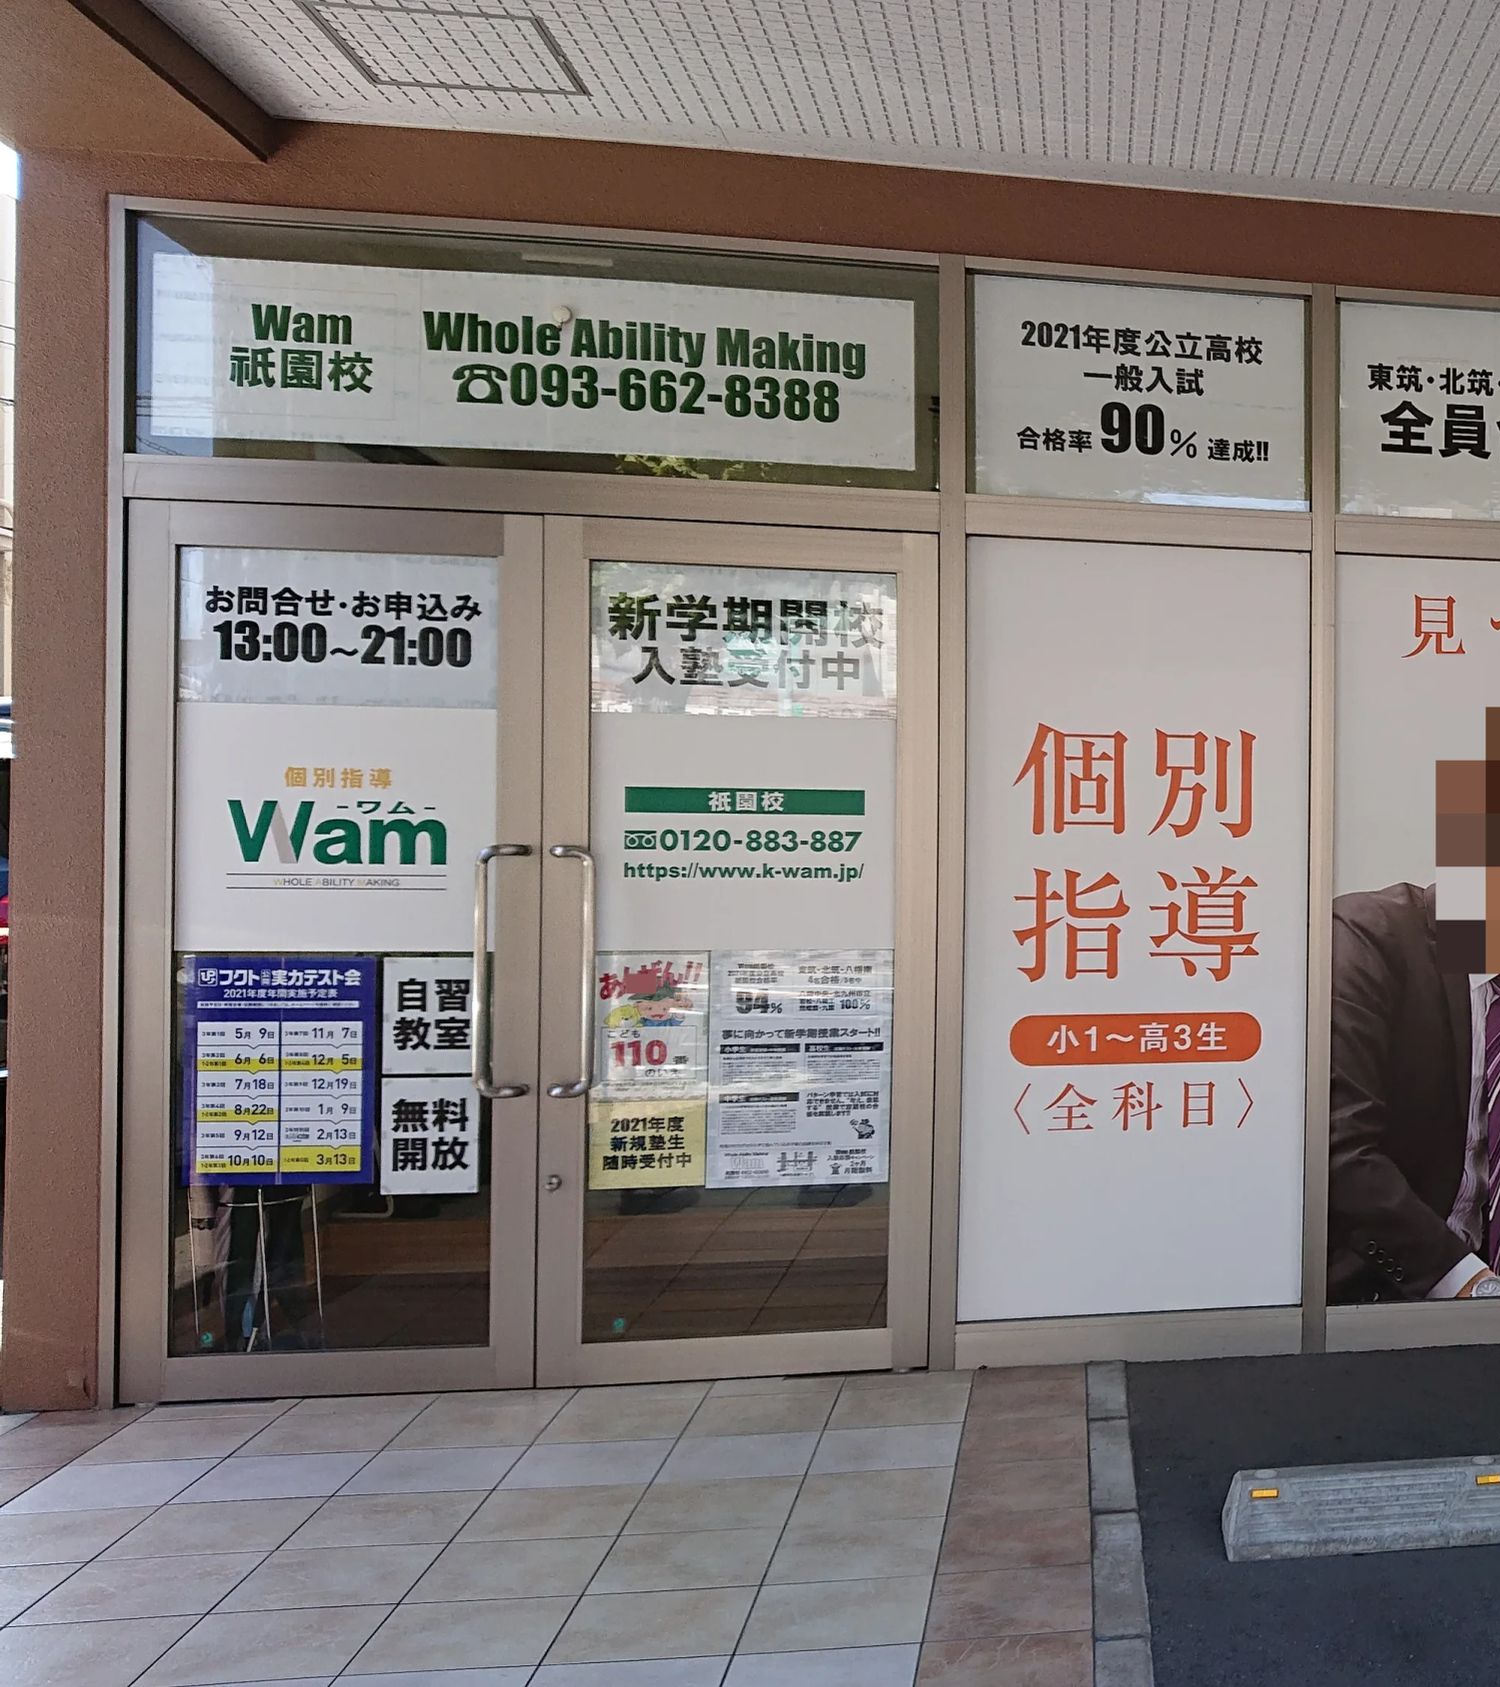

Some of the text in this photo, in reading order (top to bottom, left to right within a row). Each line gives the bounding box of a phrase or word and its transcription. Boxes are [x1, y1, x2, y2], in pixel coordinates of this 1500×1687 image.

[252, 303, 352, 346] Wam
[423, 310, 866, 381] Whole Ability Making
[1021, 320, 1263, 366] 2021年度公立高校
[229, 346, 373, 394] 祇園校
[1083, 362, 1205, 397] 一般入試
[510, 361, 841, 425] 093-662-8388
[1016, 401, 1269, 464] 合格率 90% 達成!!
[205, 585, 482, 622] お問合せ・お申込み
[212, 619, 473, 668] 13:00～21:00
[631, 645, 861, 690] 入塾受付中
[284, 766, 393, 789] 個別指導
[1012, 722, 1257, 840] 個別
[707, 790, 785, 813] 祇園校
[227, 799, 448, 866] Wam
[659, 828, 863, 853] 0120-883-887
[273, 877, 401, 887] WHOLE ABILITY MAKING
[623, 861, 865, 883] https://www.k-wam.jp/
[1012, 865, 1260, 983] 指導
[397, 978, 470, 1012] 自習
[393, 1017, 471, 1051] 教室
[607, 1029, 641, 1039] こども
[391, 1098, 469, 1133] 無料
[610, 1116, 685, 1133] 2021年度
[391, 1137, 470, 1172] 開放
[609, 1133, 685, 1151] 新規塾生
[602, 1152, 692, 1171] 随時受付中
